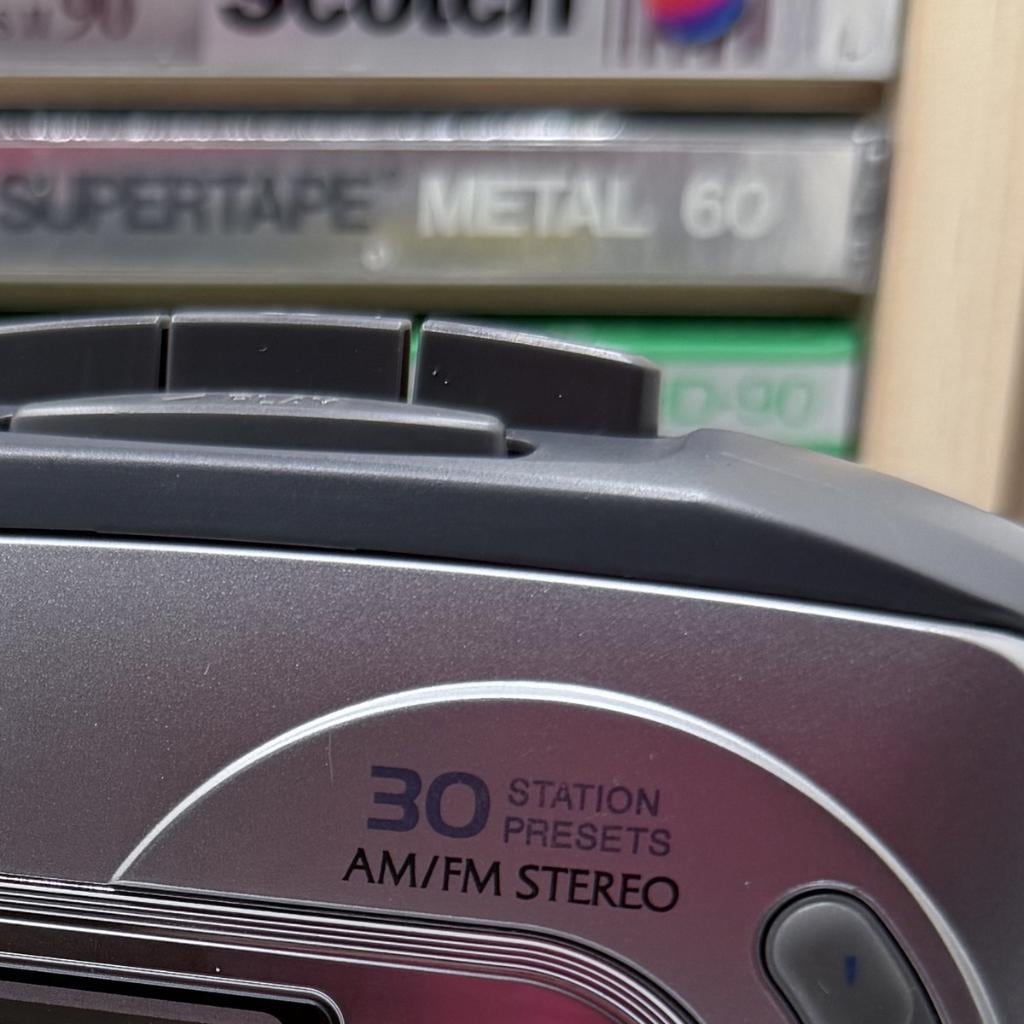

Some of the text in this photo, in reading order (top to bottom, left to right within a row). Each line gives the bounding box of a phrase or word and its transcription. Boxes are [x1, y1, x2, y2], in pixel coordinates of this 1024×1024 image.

[416, 178, 648, 240] METAL
[680, 180, 776, 240] 60
[366, 765, 661, 838] 30 STATION
[502, 816, 672, 857] PRESETS
[342, 847, 680, 913] AM/FM STEREO
